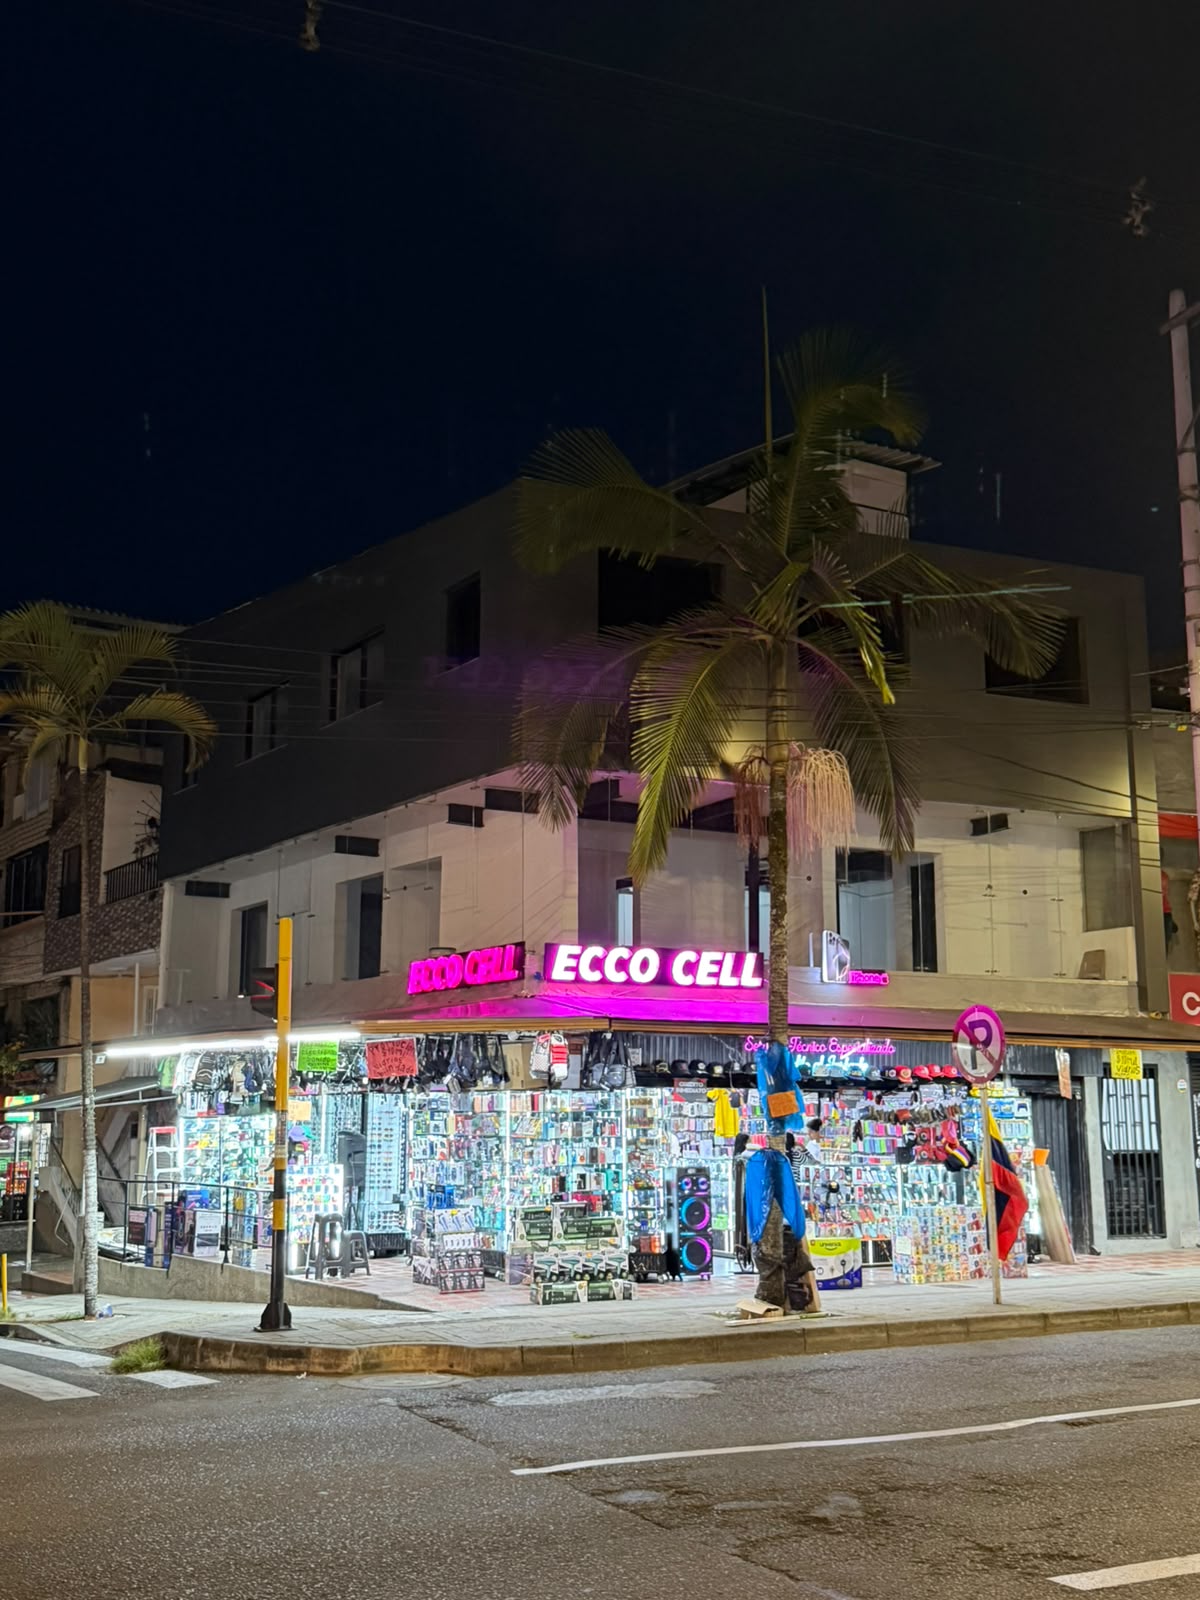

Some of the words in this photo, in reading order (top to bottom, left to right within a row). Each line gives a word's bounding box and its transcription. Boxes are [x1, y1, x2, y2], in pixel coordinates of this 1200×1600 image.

[407, 954, 464, 995] ECCO
[463, 945, 519, 986] CELL
[550, 944, 660, 984] ECCO
[671, 950, 764, 987] CELL
[966, 1018, 993, 1071] P
